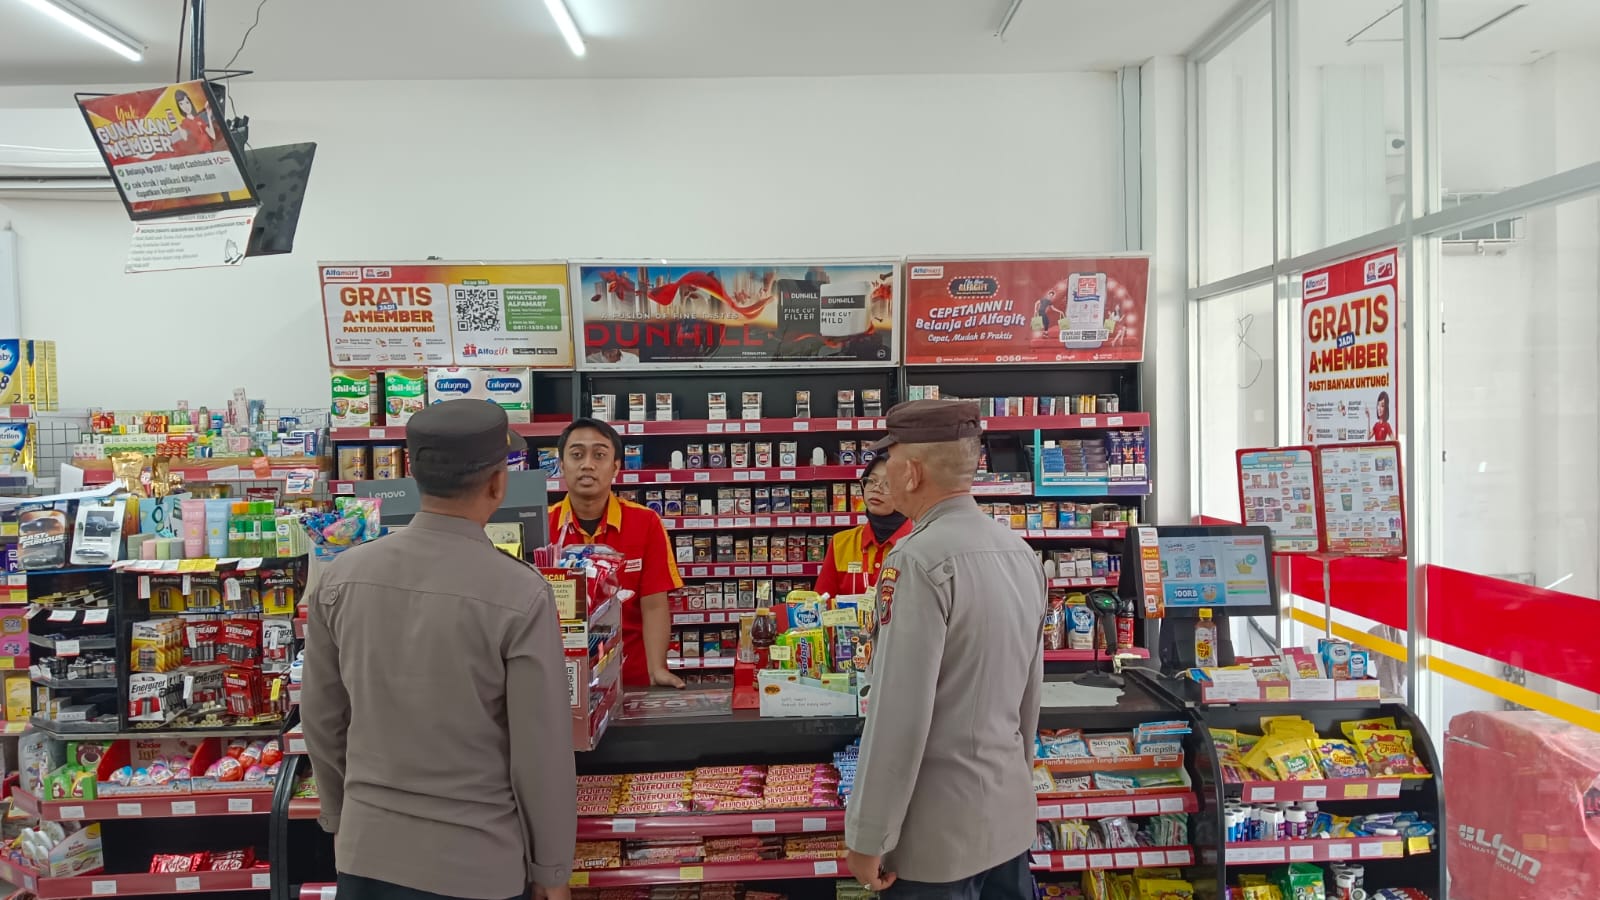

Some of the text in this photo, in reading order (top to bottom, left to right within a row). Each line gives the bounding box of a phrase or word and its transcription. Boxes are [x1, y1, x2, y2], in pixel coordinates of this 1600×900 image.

[97, 119, 171, 143] GUNAKAN
[105, 135, 174, 159] MEMBER
[1306, 274, 1327, 289] Alfamart
[340, 287, 433, 306] GRATIS
[614, 312, 650, 320] FUSION
[929, 301, 1002, 319] CEPETANNN
[915, 313, 1026, 332] Belanja di Alfagift
[1308, 294, 1389, 343] GRATIS
[399, 325, 435, 333] UNTUNG!
[584, 322, 768, 347] DUNHILL
[952, 332, 978, 342] Mudah
[987, 331, 1013, 340] Praktis
[1338, 334, 1354, 347] JADI
[478, 347, 508, 355] Alfagift
[1309, 372, 1390, 392] PASTI BANYAK UNTUNG!
[520, 401, 528, 410] 4
[369, 486, 406, 500] Lenovo
[20, 533, 45, 544] FAST
[23, 535, 67, 549] FURIOUS
[1174, 591, 1198, 599] 100RB
[131, 680, 166, 694] Energizer
[1091, 738, 1128, 747] Strepsils
[1142, 744, 1177, 754] Strepsils
